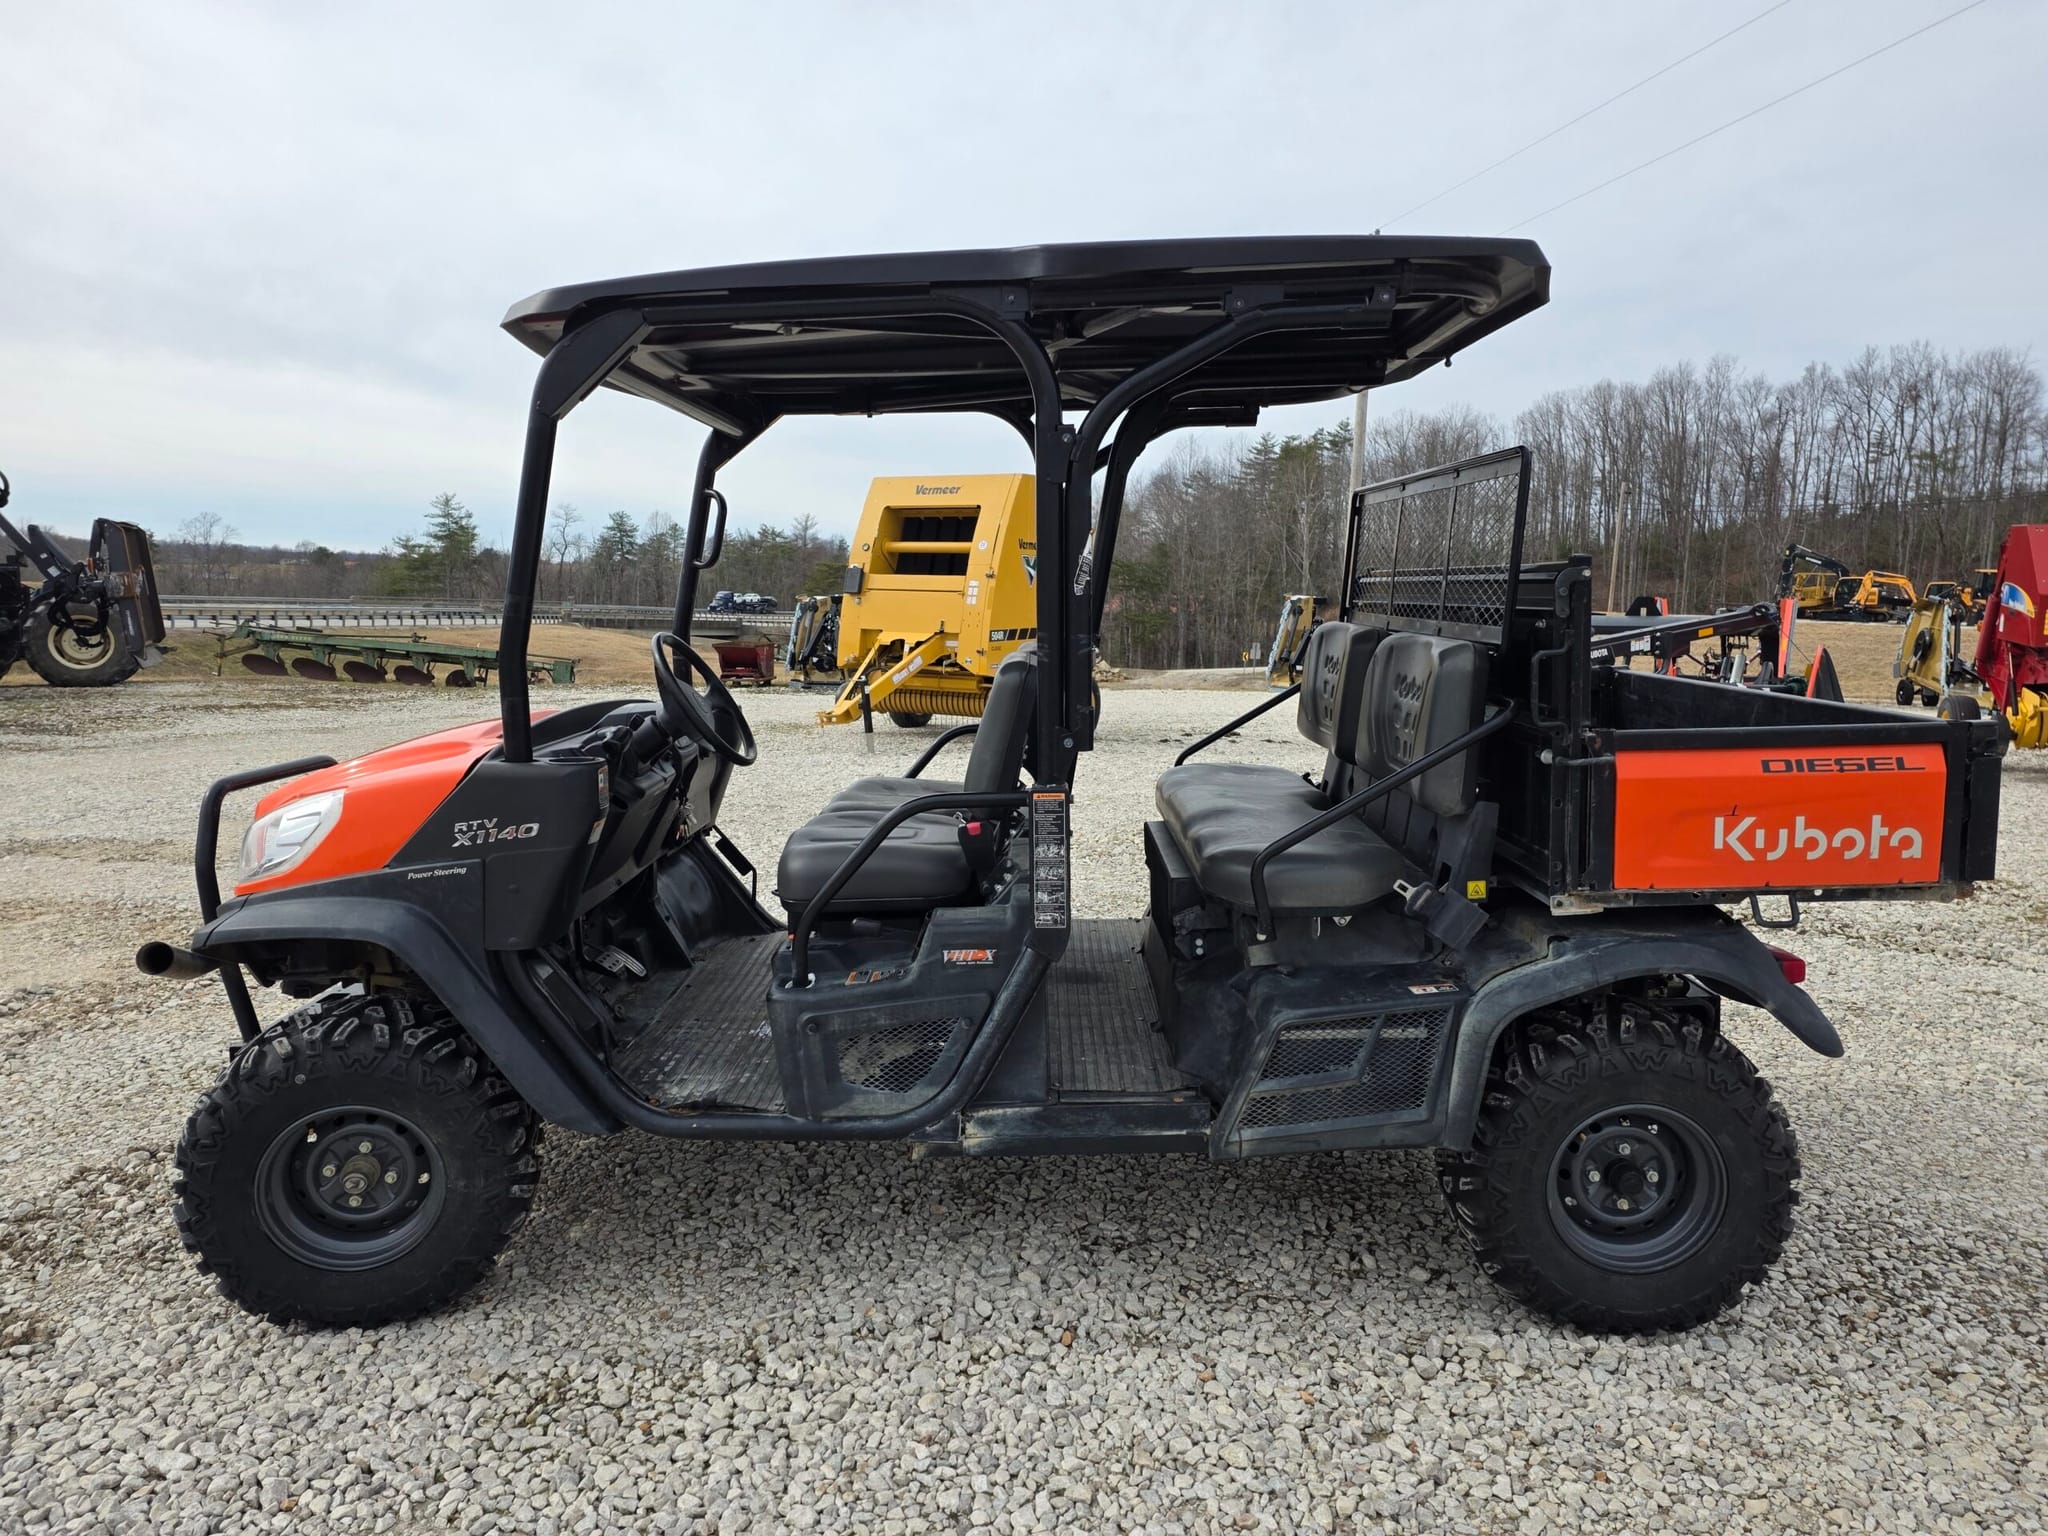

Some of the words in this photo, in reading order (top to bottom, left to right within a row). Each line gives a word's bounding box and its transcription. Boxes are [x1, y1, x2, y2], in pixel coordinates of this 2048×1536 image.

[915, 485, 961, 496] Vermeer
[1018, 538, 1037, 550] Verme
[1590, 648, 1609, 659] UBOTA
[1760, 756, 1926, 774] DIESEL
[454, 818, 498, 833] RTV
[452, 823, 540, 847] X1140
[1713, 814, 1923, 861] Kubota
[407, 871, 433, 880] Power
[433, 866, 467, 876] Steering
